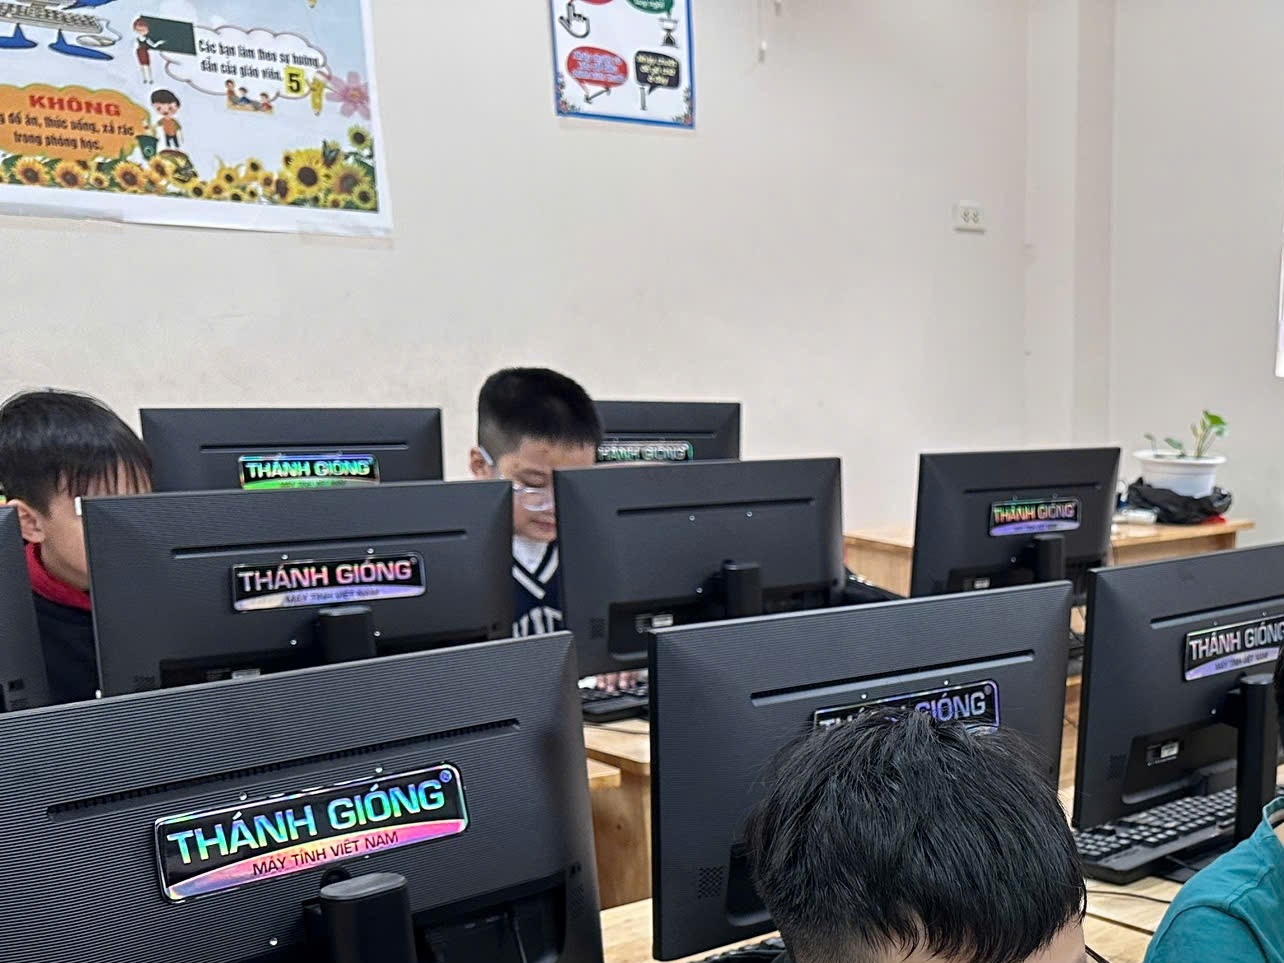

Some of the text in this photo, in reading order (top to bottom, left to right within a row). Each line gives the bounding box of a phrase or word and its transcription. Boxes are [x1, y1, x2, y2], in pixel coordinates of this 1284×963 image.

[288, 73, 300, 93] 5
[28, 94, 121, 117] KHÔNG
[245, 459, 311, 478] THÁNH
[237, 557, 413, 593] THÁNH GIÓNG
[1189, 631, 1241, 660] THÁNH
[167, 779, 445, 864] THÁNH GIÓNG
[253, 853, 288, 876] MÁY
[291, 845, 327, 867] TÍNH
[365, 831, 399, 849] NAM
